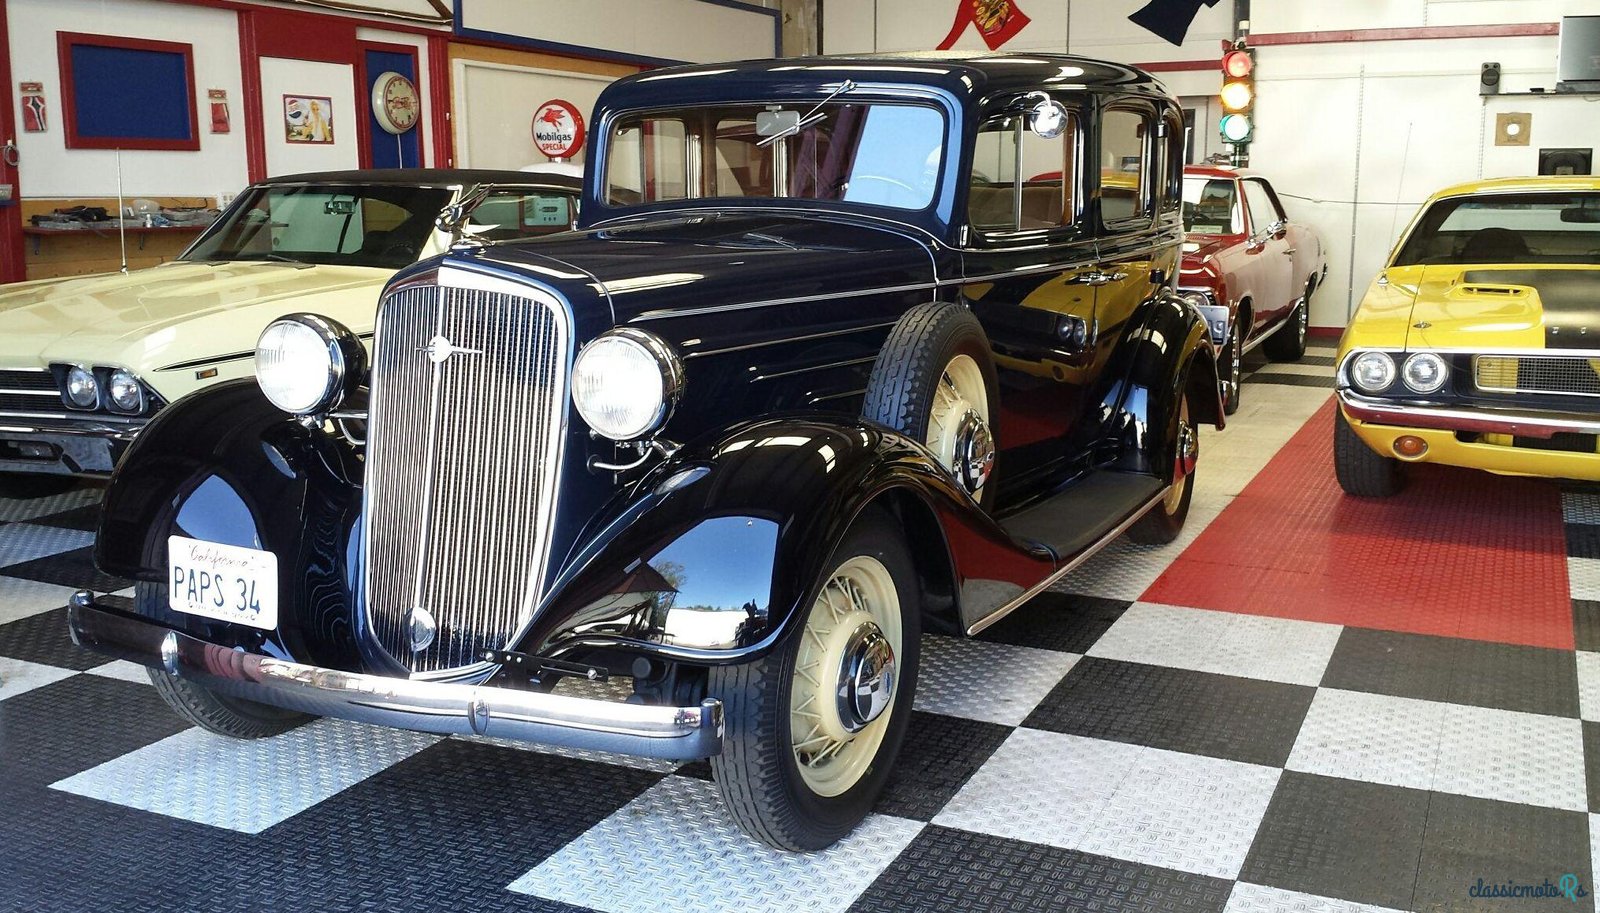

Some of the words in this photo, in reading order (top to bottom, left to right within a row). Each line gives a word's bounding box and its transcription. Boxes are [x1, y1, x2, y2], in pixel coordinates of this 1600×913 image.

[536, 132, 572, 143] Mobilgas
[174, 565, 224, 607] PAPS
[236, 578, 261, 614] 34
